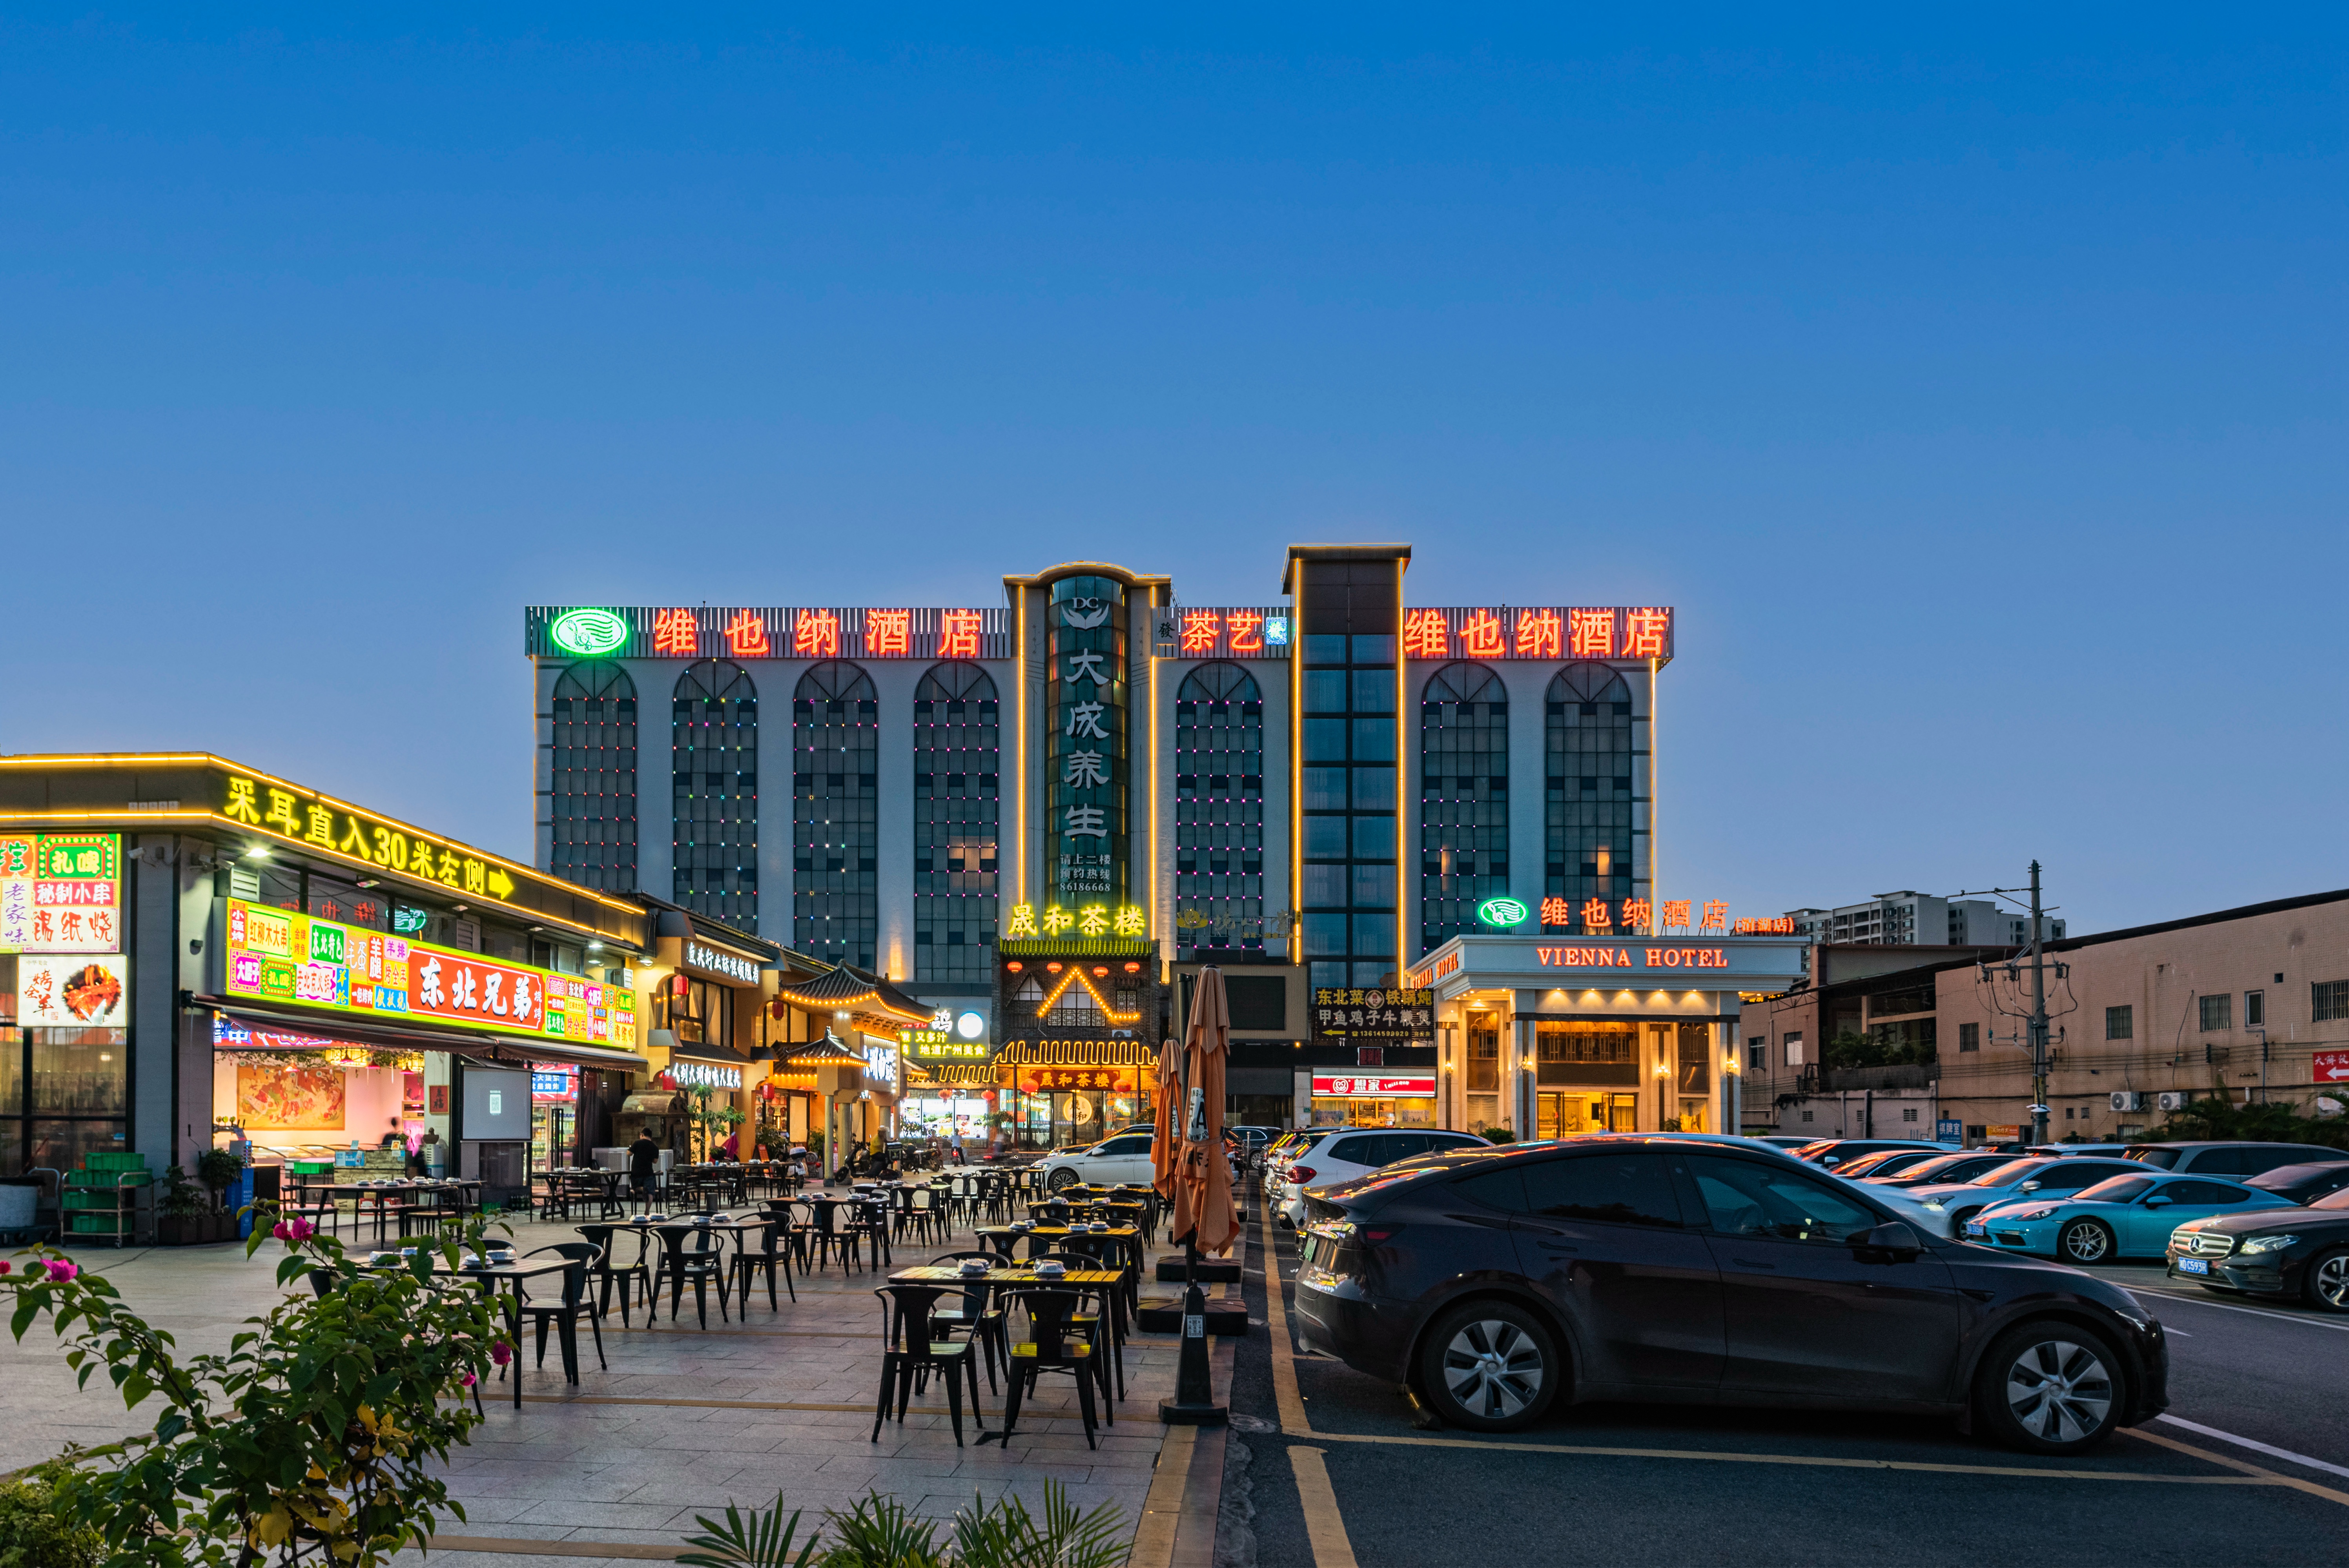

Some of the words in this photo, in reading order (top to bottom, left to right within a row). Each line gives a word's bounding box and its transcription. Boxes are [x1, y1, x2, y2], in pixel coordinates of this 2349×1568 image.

[1072, 597, 1099, 609] DC
[654, 608, 981, 655] 维也纳酒店
[1158, 622, 1175, 639] 發
[1182, 613, 1261, 650] 茶艺
[1404, 608, 1667, 656] 维也纳酒店
[1064, 648, 1109, 838] 大成养生
[224, 776, 485, 894] 采耳直入30米左侧
[51, 850, 100, 874] 扎啤
[1060, 854, 1111, 865] 请上二楼
[1060, 868, 1110, 880] 预约热线
[36, 883, 111, 905] 秘制小串
[1060, 882, 1110, 892] 86186668
[4, 883, 28, 943] 老家味
[1008, 905, 1145, 936] 晟和茶楼
[1540, 898, 1729, 929] 维也纳酒店
[32, 909, 113, 943] 锡纸烧
[250, 920, 287, 949] 红柳木大串
[312, 928, 343, 960] 东北特色
[346, 939, 366, 971] 毛蛋
[386, 940, 406, 958] 羊排
[369, 937, 382, 979] 羊腿
[1436, 952, 1458, 979] HOTEL
[1536, 947, 1632, 967] VIENNA
[1645, 948, 1728, 968] HOTEL
[268, 970, 290, 987] 扎啤
[297, 968, 330, 993] 老北京火锅
[384, 962, 406, 987] 烤全羊
[24, 968, 54, 1017] 烤全羊
[420, 956, 532, 1022] 东北兄弟
[1317, 989, 1365, 1005] 东北菜
[1385, 989, 1432, 1006] 铁锅炖
[534, 990, 542, 1022] 烧烤
[931, 1009, 953, 1033] 鸽
[915, 1031, 948, 1043] 又多汁
[919, 1044, 985, 1056] 地道广州美食
[1040, 1072, 1110, 1087] 晟和茶楼
[1354, 1078, 1380, 1091] 想家
[1939, 1122, 1960, 1135] 棋牌室
